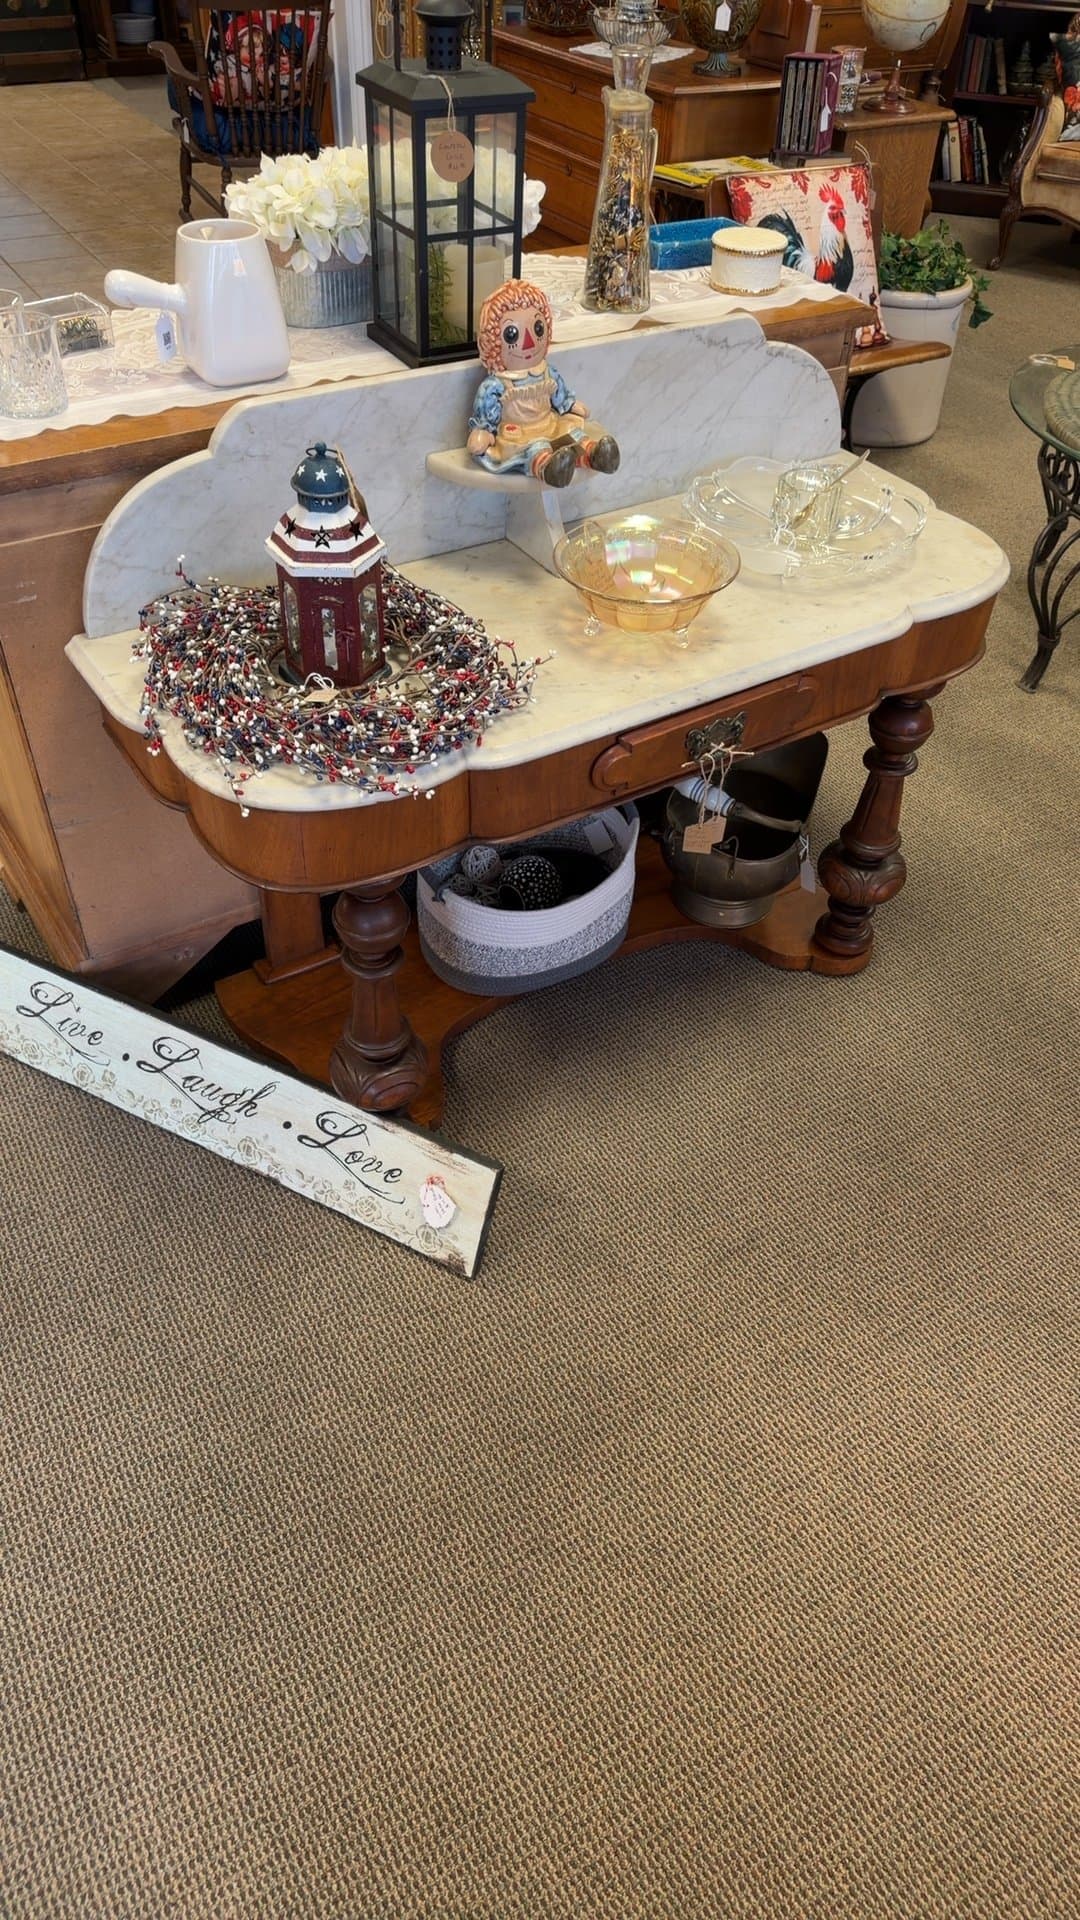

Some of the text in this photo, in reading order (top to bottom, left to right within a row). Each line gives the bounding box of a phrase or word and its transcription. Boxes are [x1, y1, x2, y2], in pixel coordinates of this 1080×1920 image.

[17, 981, 406, 1204] Live Laugh Love
